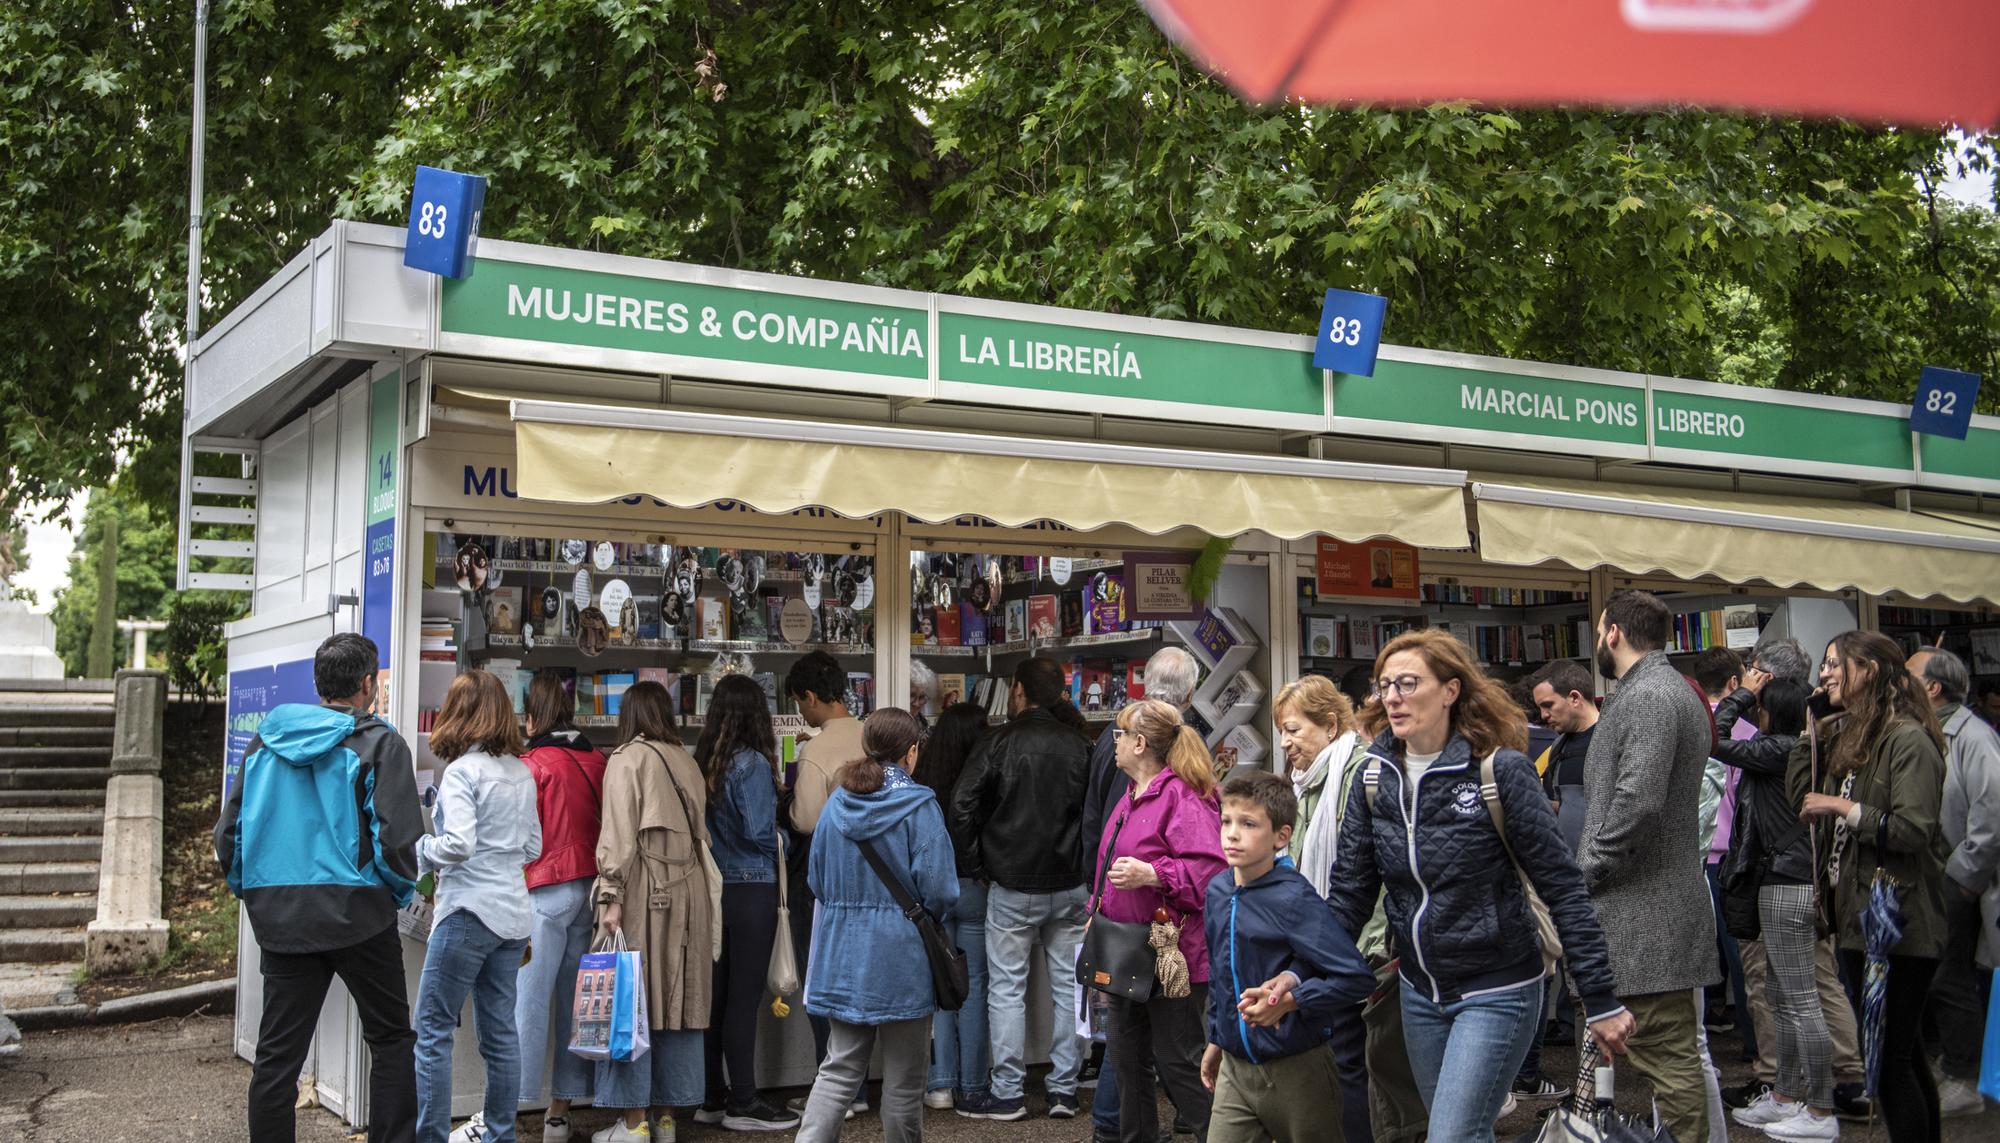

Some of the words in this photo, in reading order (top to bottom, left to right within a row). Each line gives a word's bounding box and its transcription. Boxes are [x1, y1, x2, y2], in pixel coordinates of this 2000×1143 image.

[418, 201, 447, 239] 83
[507, 283, 689, 335] MUJERES
[699, 306, 723, 338] &
[732, 309, 924, 358] COMPAÑÍA
[1329, 316, 1361, 346] 83
[959, 334, 1000, 366] LA
[1008, 339, 1142, 380] LIBRERÍA
[1460, 384, 1570, 421] MARCIAL
[1575, 398, 1639, 427] PONS
[1925, 388, 1957, 415] 82
[1657, 407, 1745, 438] LIBRERO
[378, 450, 393, 490] 14
[373, 490, 395, 515] BLOQUE
[372, 533, 394, 555] CASETAS
[1146, 576, 1182, 585] BELLVER
[1151, 567, 1177, 577] PILAR
